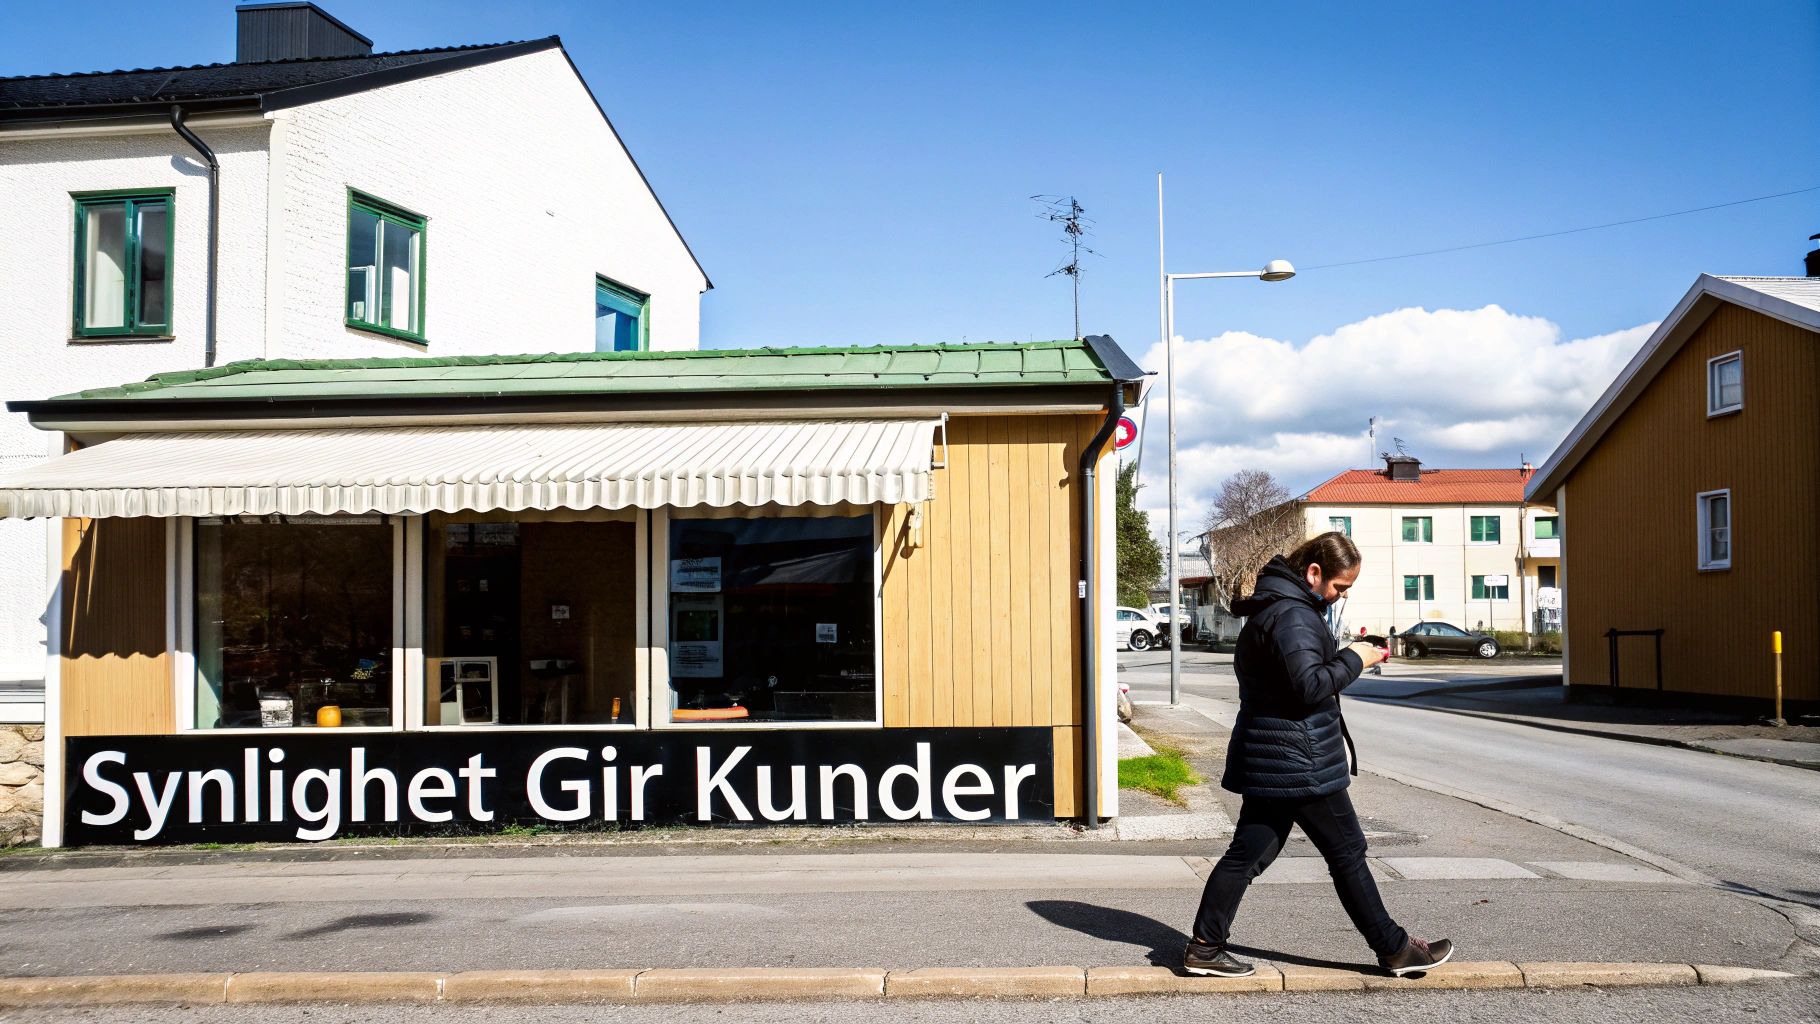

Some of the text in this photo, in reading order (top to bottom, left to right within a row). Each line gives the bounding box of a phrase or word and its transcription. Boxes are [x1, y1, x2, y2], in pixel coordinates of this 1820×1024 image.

[81, 742, 1036, 841] Synlighet Gir Kunder
